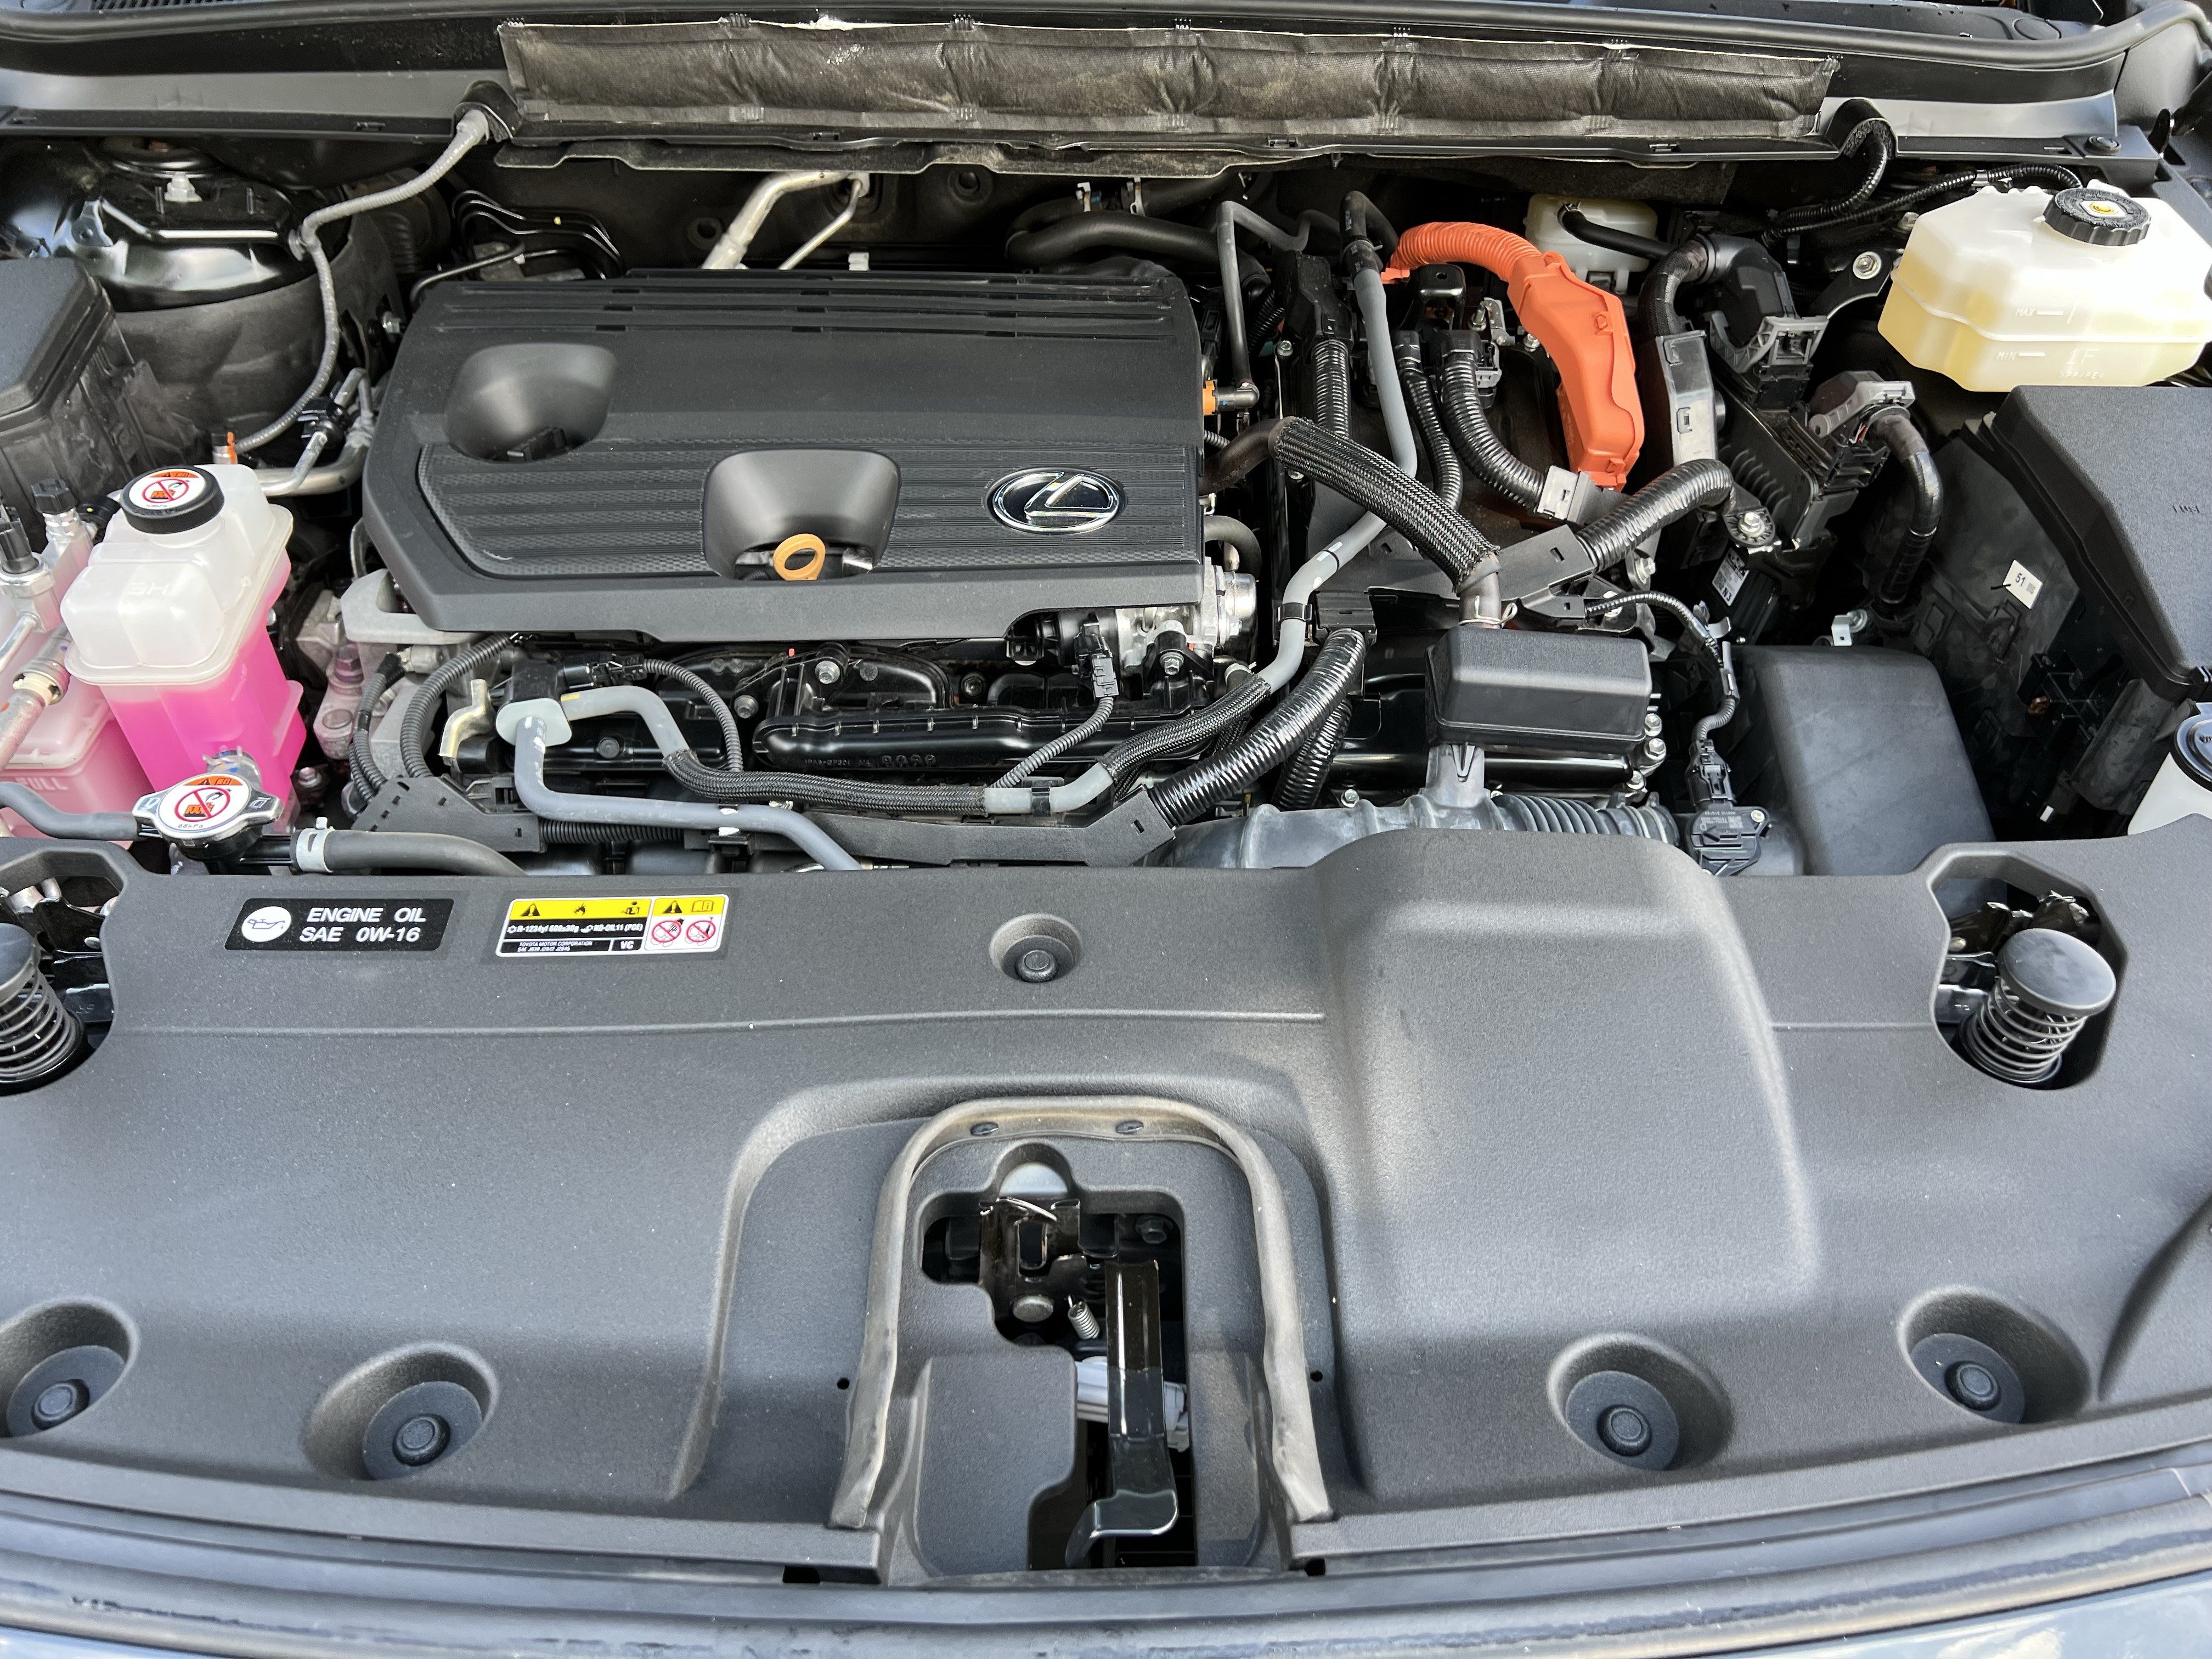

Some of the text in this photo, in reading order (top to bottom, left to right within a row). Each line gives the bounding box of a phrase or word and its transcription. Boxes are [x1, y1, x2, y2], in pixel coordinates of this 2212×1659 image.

[2015, 307, 2036, 317] MAX
[1996, 351, 2017, 360] MIN
[2015, 572, 2026, 587] 51
[1722, 587, 1733, 602] N3
[307, 907, 426, 922] ENGINE OIL
[299, 927, 421, 943] SAE 0W-16
[620, 940, 634, 950] VC
